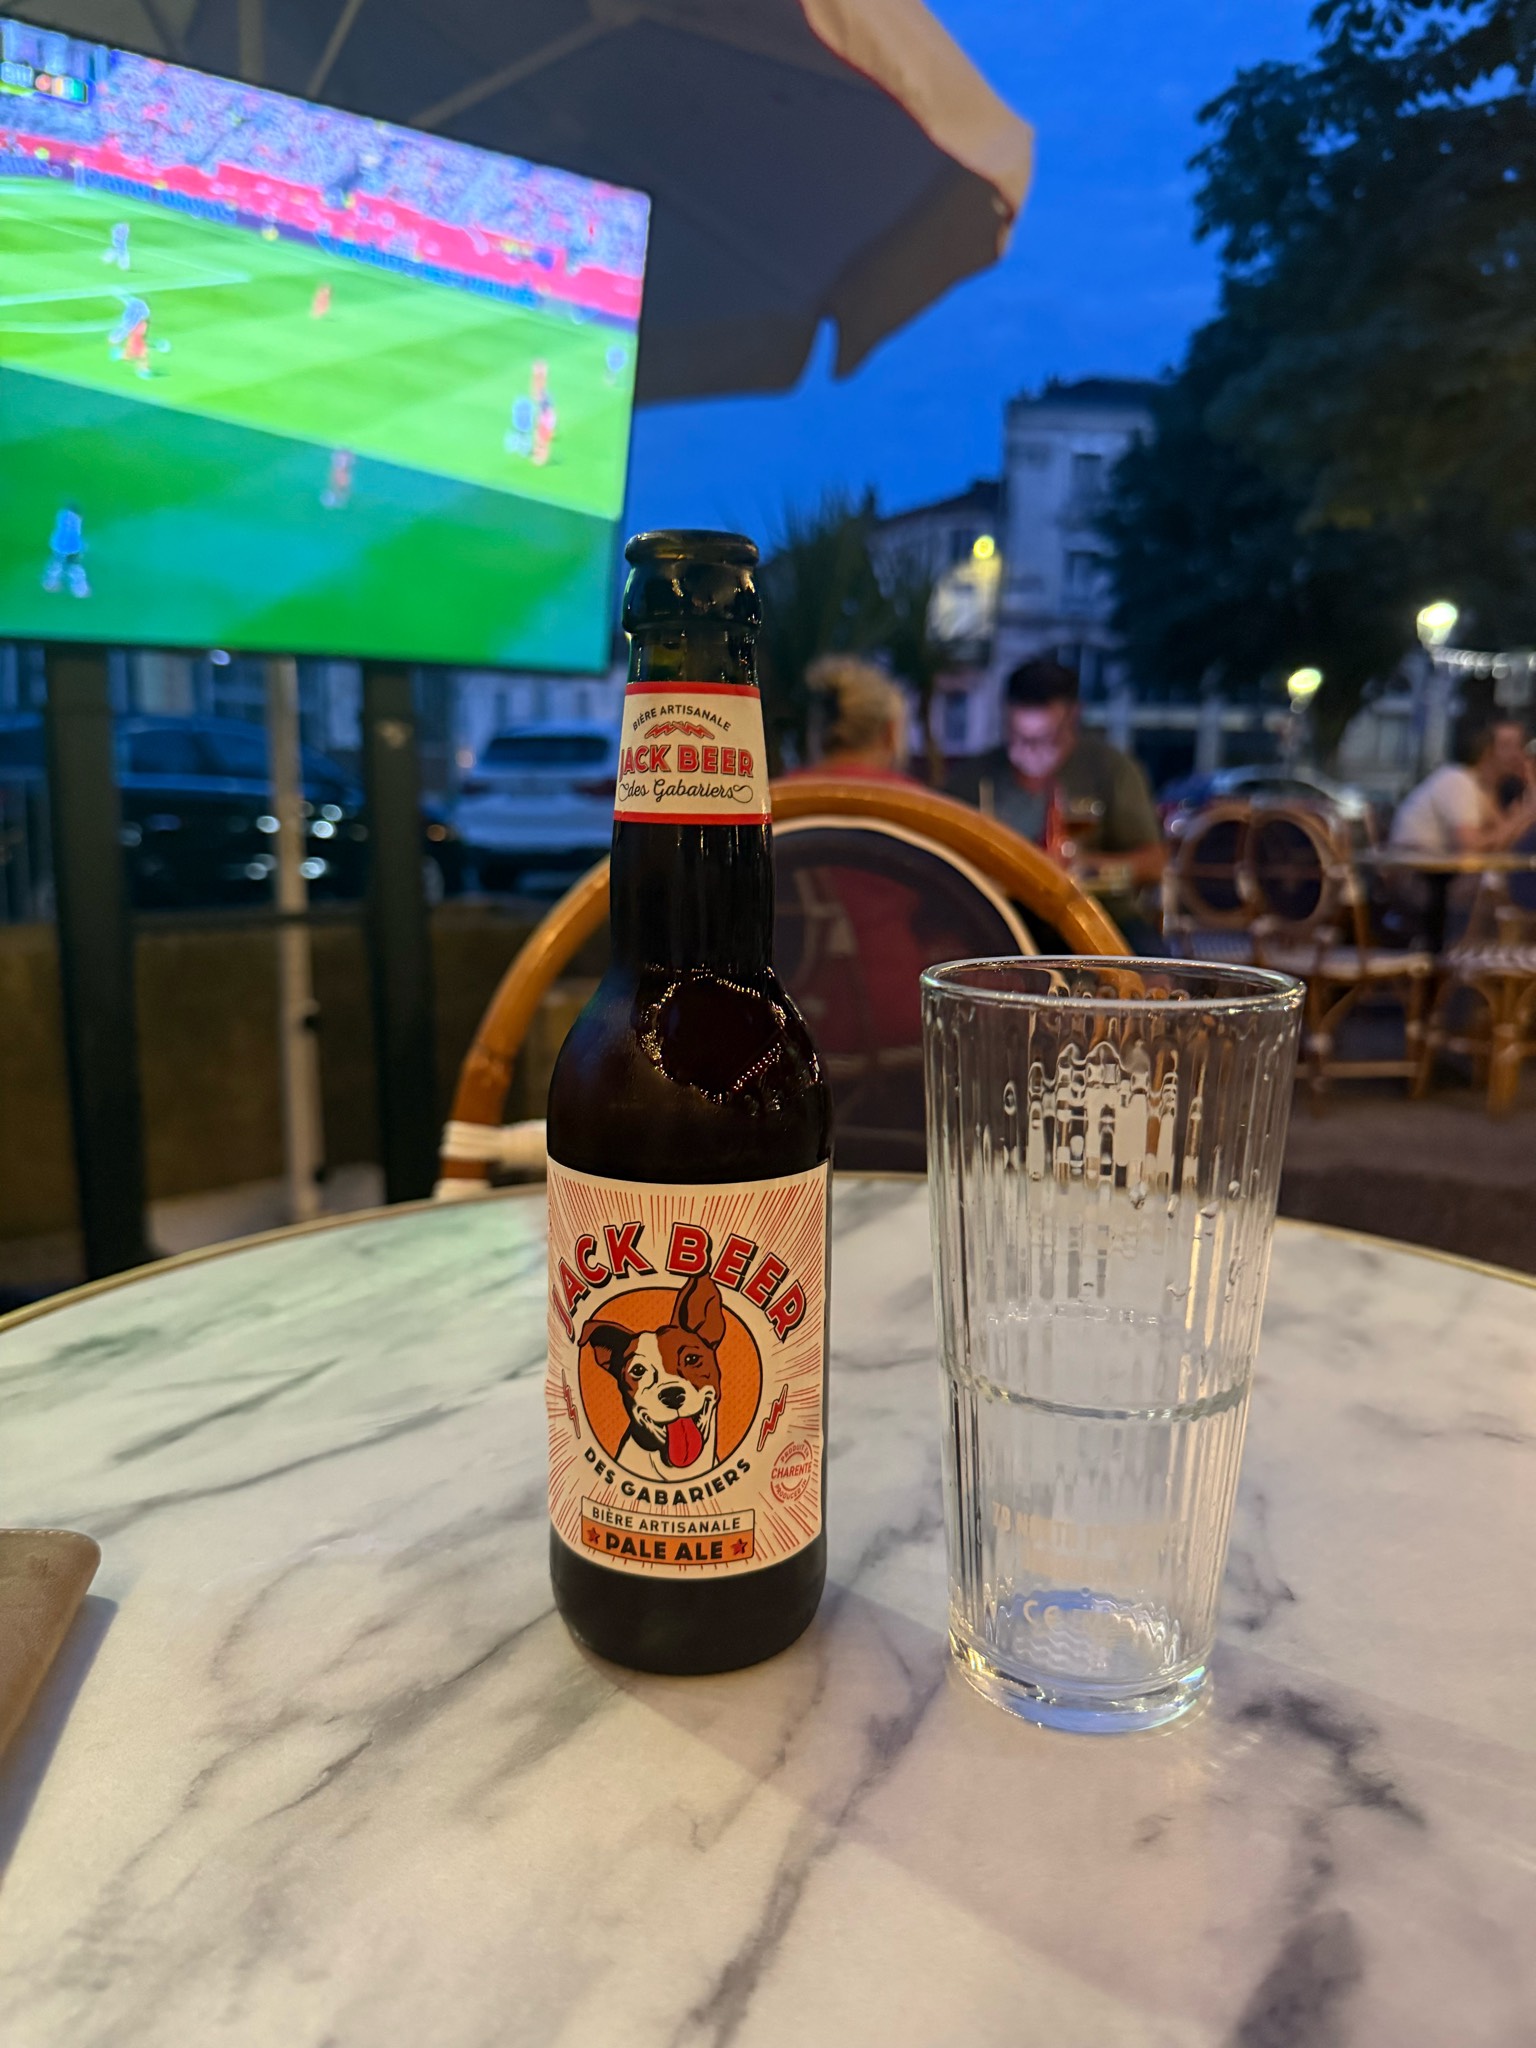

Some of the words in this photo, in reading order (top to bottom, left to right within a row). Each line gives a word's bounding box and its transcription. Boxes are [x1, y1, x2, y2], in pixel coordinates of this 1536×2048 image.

[632, 705, 657, 732] BIÈRE
[660, 704, 731, 732] ARTISANALE
[619, 744, 672, 783] JACK
[677, 743, 754, 778] BEER
[624, 779, 650, 799] des
[653, 779, 742, 802] Gabariers
[552, 1221, 657, 1344] JACK
[665, 1221, 807, 1344] BEER
[584, 1446, 616, 1485] DES
[621, 1457, 751, 1506] GABARIERS
[771, 1461, 812, 1479] CHARENTE
[592, 1507, 633, 1528] BIÈRE
[639, 1517, 741, 1534] ARTISANALE
[605, 1532, 666, 1560] PALE
[674, 1540, 723, 1561] ALE
